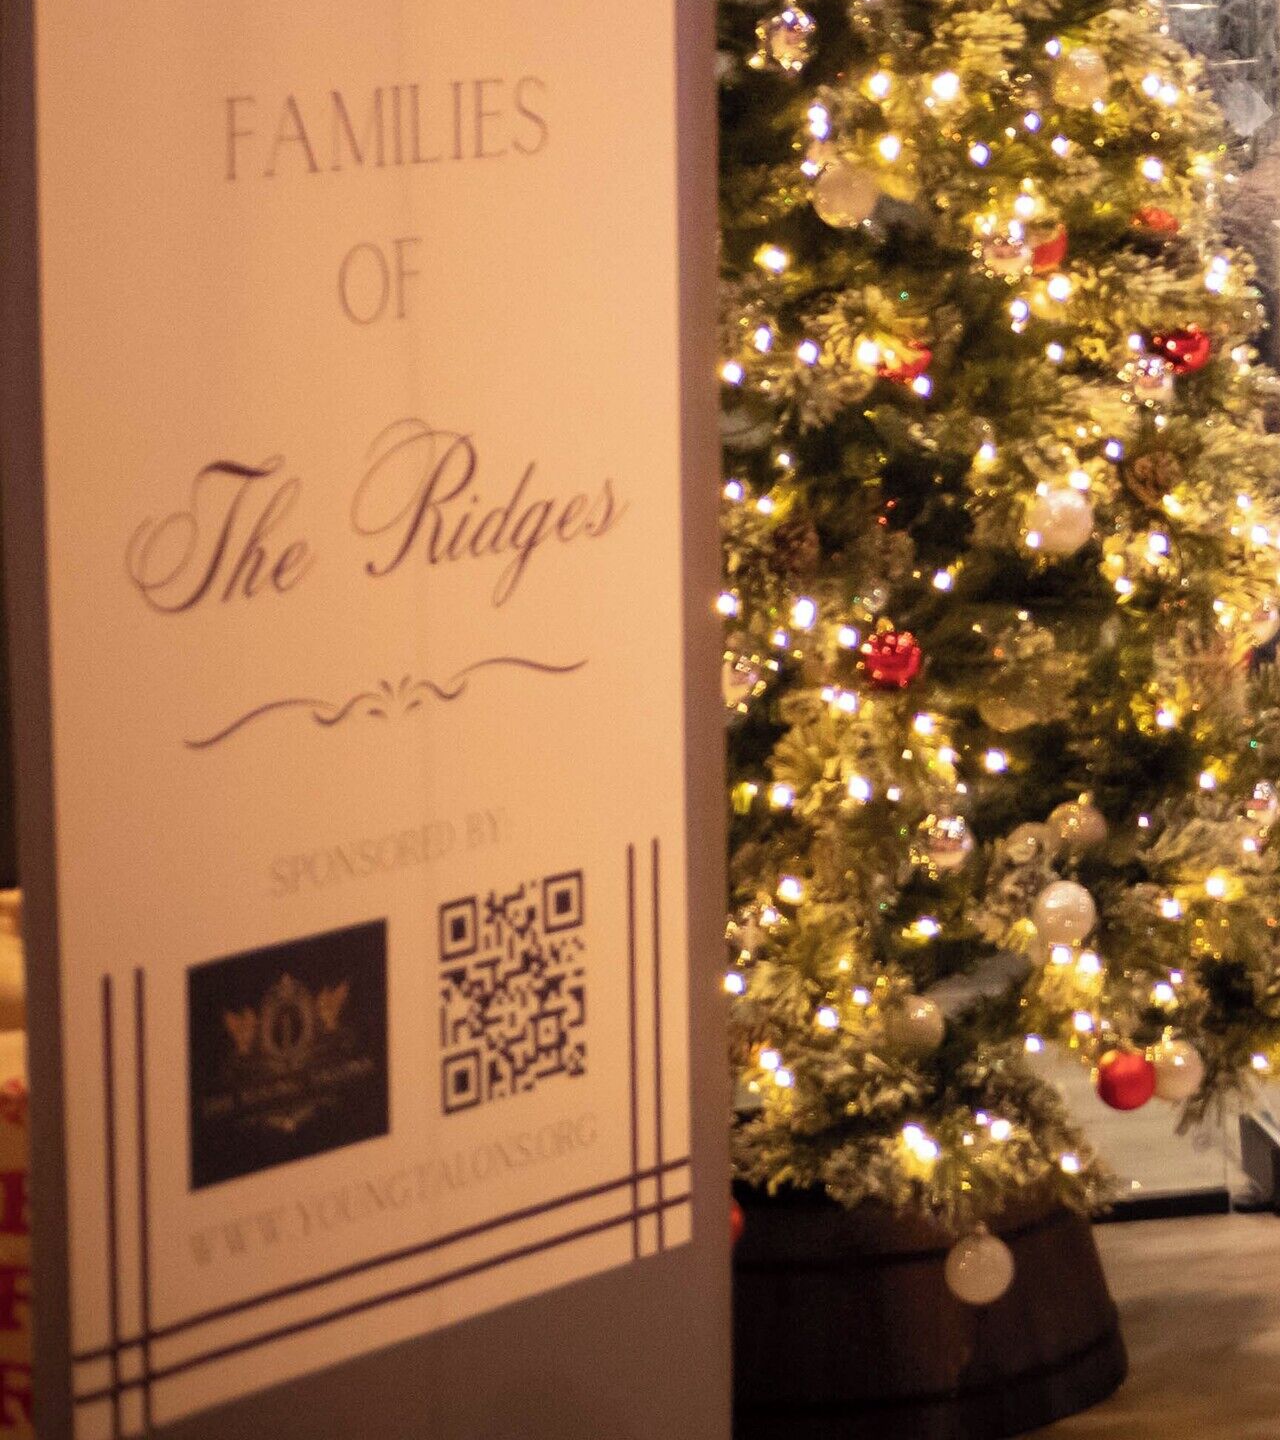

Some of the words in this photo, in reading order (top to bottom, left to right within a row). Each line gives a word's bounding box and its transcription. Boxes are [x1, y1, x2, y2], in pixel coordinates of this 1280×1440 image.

[223, 74, 550, 181] FAMILIES
[337, 236, 423, 326] OF
[124, 454, 316, 614] The
[349, 417, 628, 609] Ridges
[267, 819, 457, 897] SPONSORED
